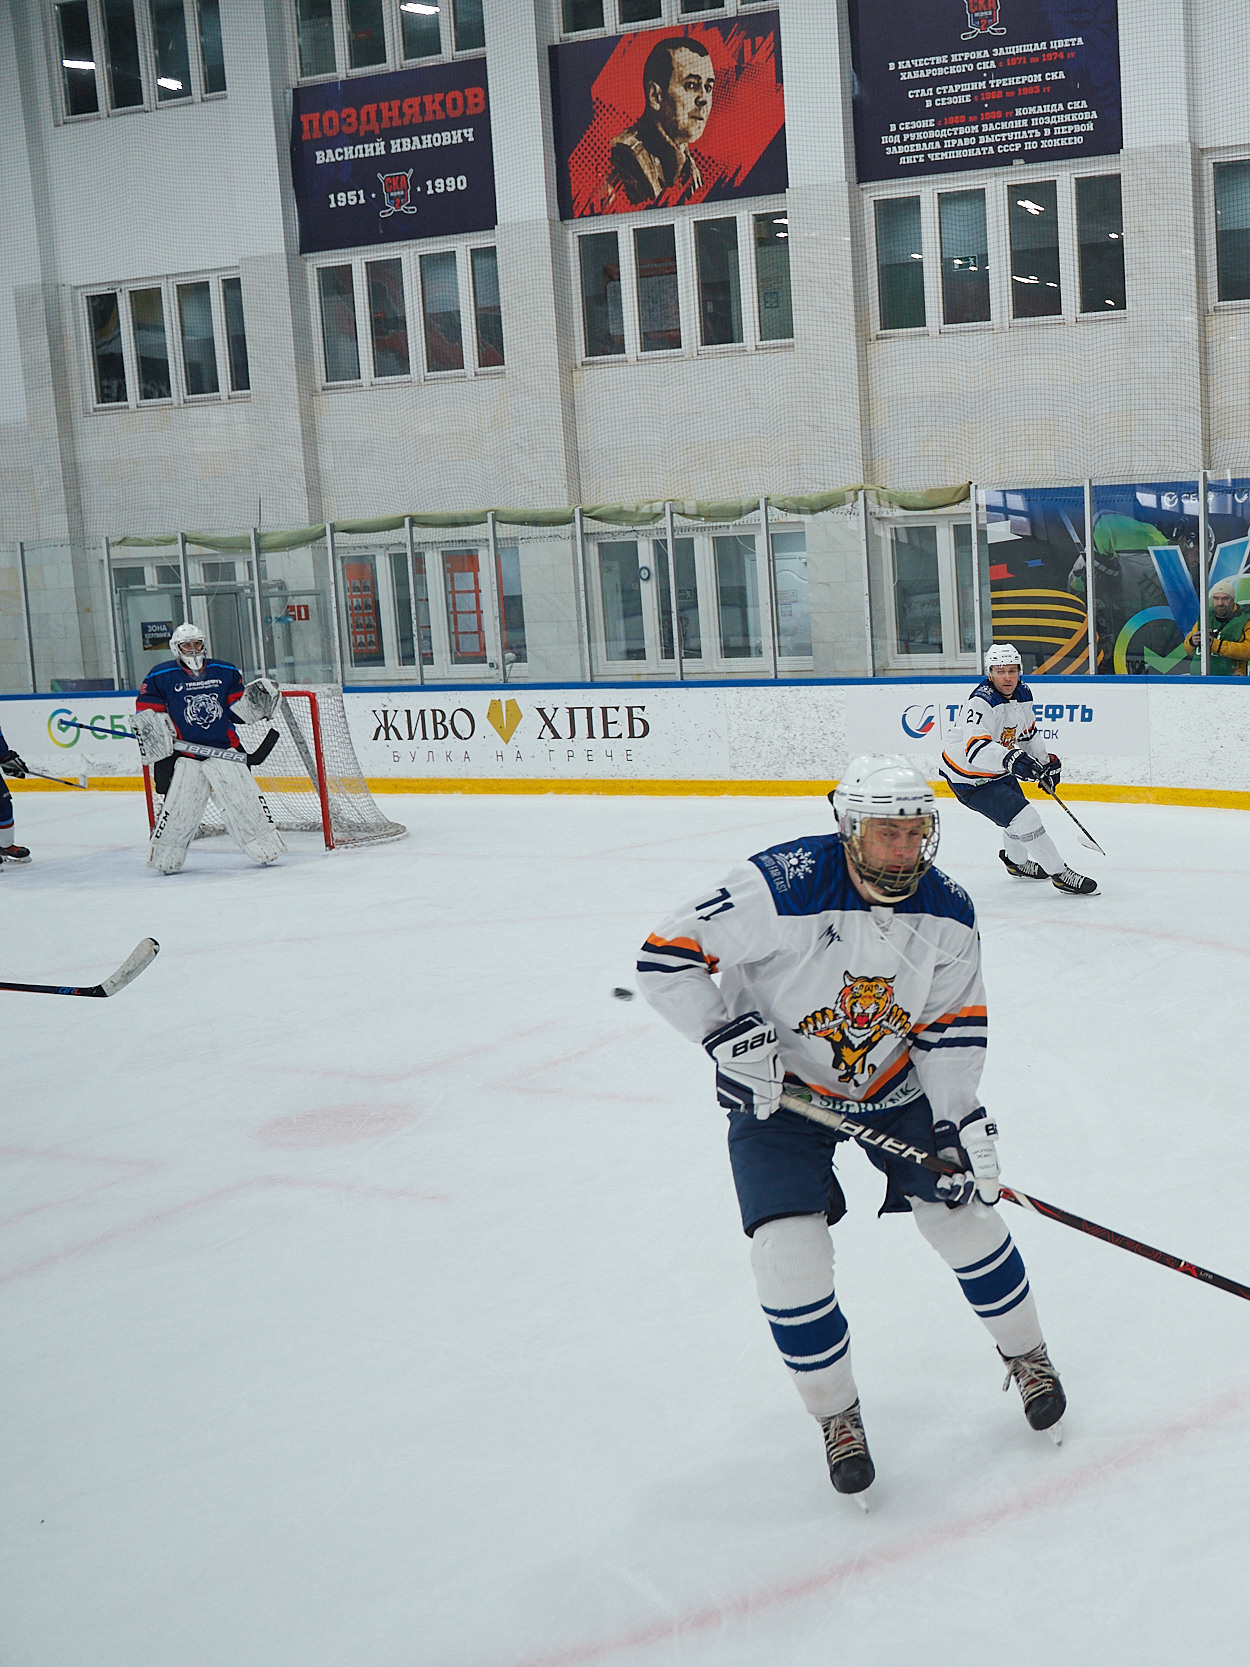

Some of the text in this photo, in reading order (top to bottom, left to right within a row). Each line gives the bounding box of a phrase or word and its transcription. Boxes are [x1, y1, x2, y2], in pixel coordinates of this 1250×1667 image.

[888, 37, 1084, 71] В КАЧЕСТВЕ ИГРОКА ЗАЩИЩАЯ ЦВЕТА
[900, 63, 974, 81] ХАБАРОВСКОГО
[976, 60, 997, 70] СКА
[908, 70, 1066, 99] СТАЛ СТАРШИМ ТРЕНЕРОМ СКА
[300, 86, 486, 141] ПОЗДНЯКОВ
[925, 99, 932, 108] В
[934, 94, 972, 107] СЕЗОНЕ
[881, 110, 1098, 144] ПОД РУКОВОДСТВОМ ВАСИЛИЯ ПОЗДНЯКОВА
[889, 123, 897, 132] В
[898, 118, 936, 132] СЕЗОНЕ
[1015, 102, 1064, 117] КОМАНДА
[1067, 100, 1088, 110] СКА
[315, 127, 475, 165] ВАСИЛИЙ ИВАНОВИЧ
[885, 121, 1094, 156] ЗАВОЕВАЛА ПРАВО ВЫСТУПАТЬ В ПЕРВОЙ
[899, 136, 1084, 165] ЛИГЕ ЧЕМПИОНАТА СССР ПО ХОККЕЮ
[328, 175, 468, 209] 1951 1990
[384, 174, 409, 193] СКА
[147, 624, 168, 633] ЗОНА
[90, 714, 137, 741] СБ
[372, 705, 650, 741] ЖИВО ХЛЕБ
[966, 708, 984, 725] 27
[188, 744, 246, 762] BAUER
[392, 750, 633, 763] БУЛКА НА ГРЕЧЕ
[258, 795, 274, 824] CCM
[155, 810, 170, 839] CCM
[768, 865, 781, 878] FAR
[773, 877, 788, 894] EAST
[732, 1029, 778, 1058] BAU
[838, 1120, 929, 1164] AUER
